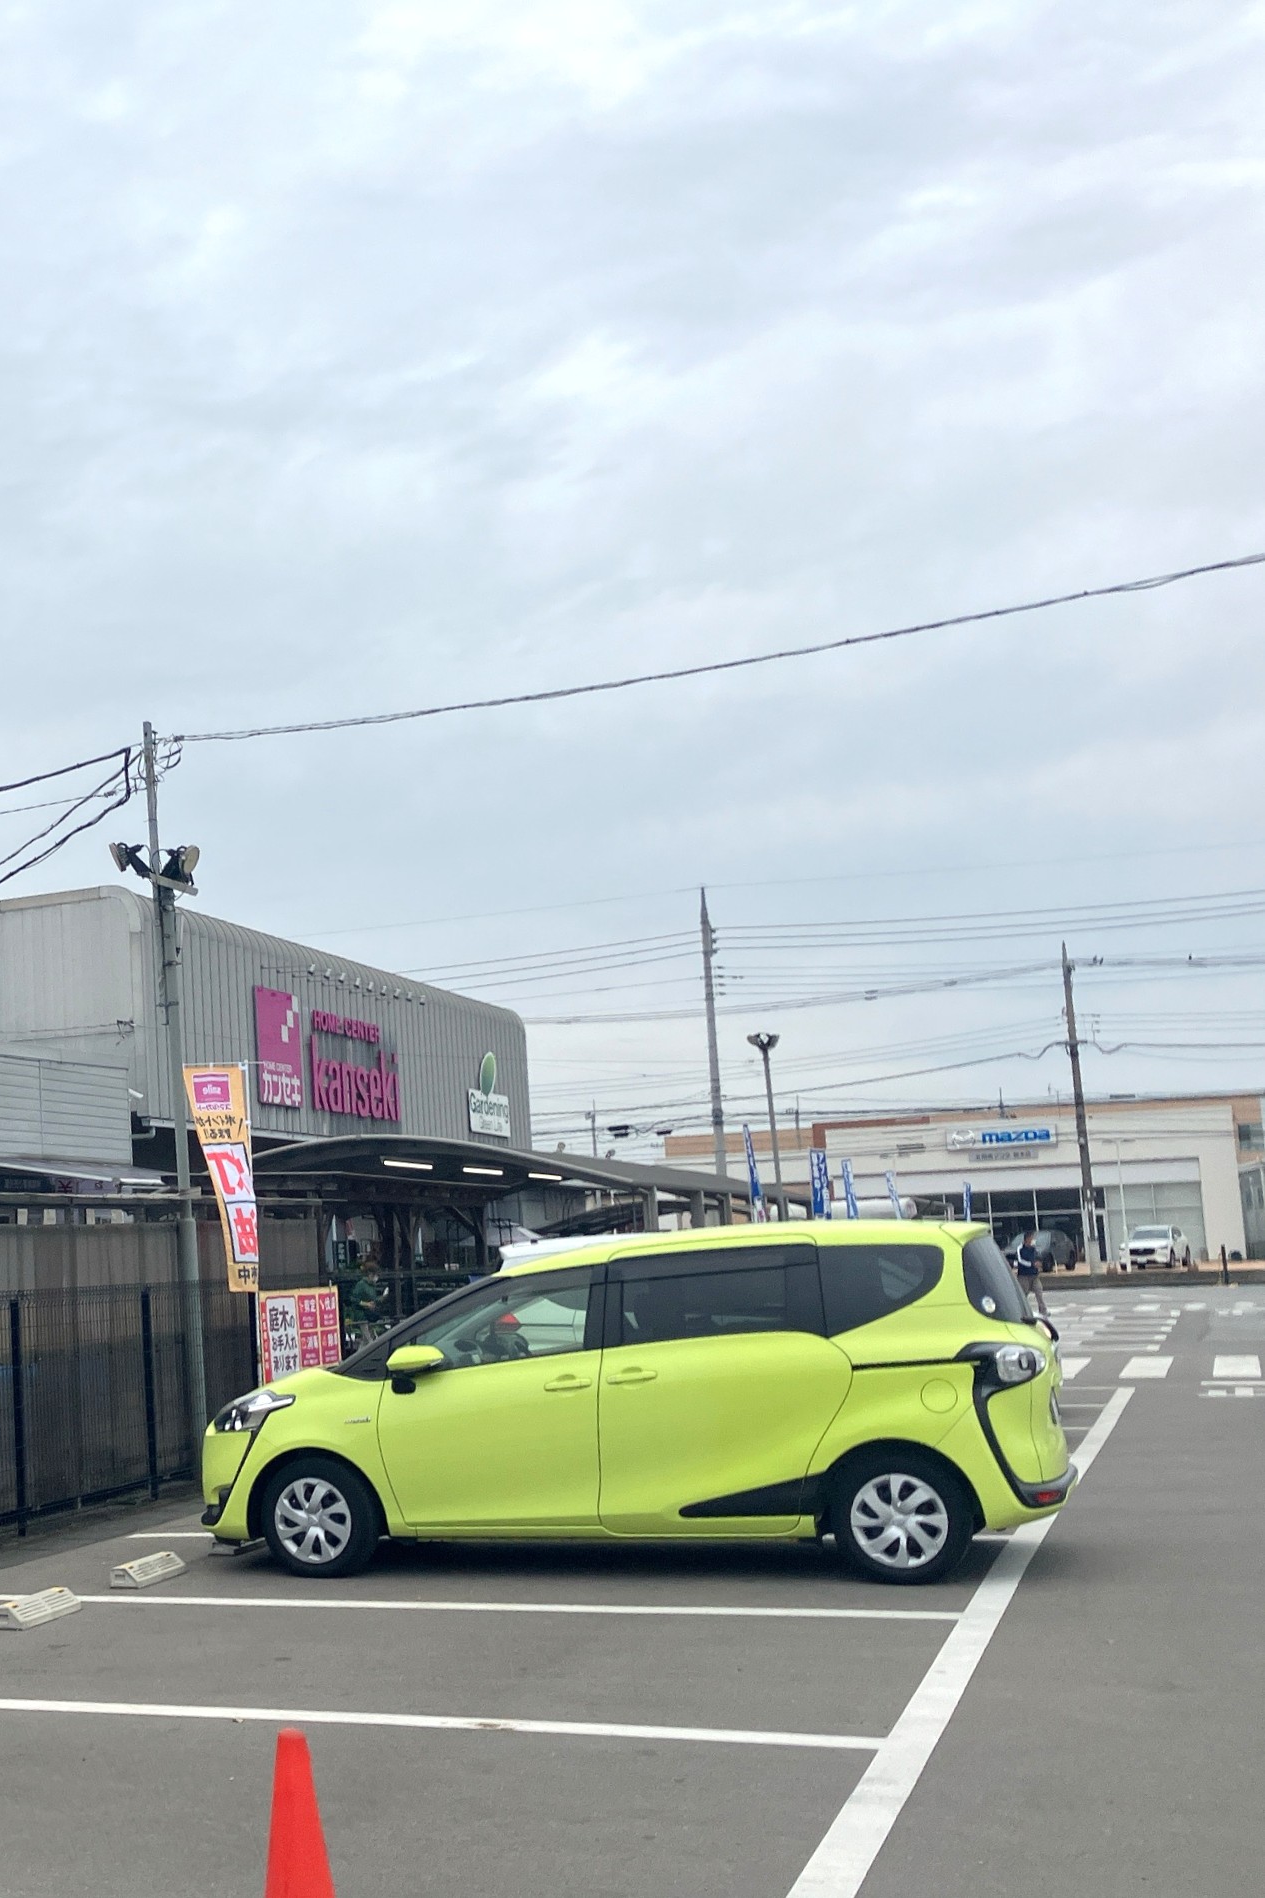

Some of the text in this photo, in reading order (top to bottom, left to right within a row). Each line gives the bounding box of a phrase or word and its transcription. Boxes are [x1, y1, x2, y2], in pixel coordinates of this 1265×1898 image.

[312, 1009, 380, 1043] HOME CENTER
[262, 1069, 301, 1106] カンセキ
[311, 1034, 401, 1121] kanseki
[470, 1091, 509, 1124] Gardening
[981, 1129, 1051, 1145] mazda
[269, 1305, 295, 1333] 庭木の
